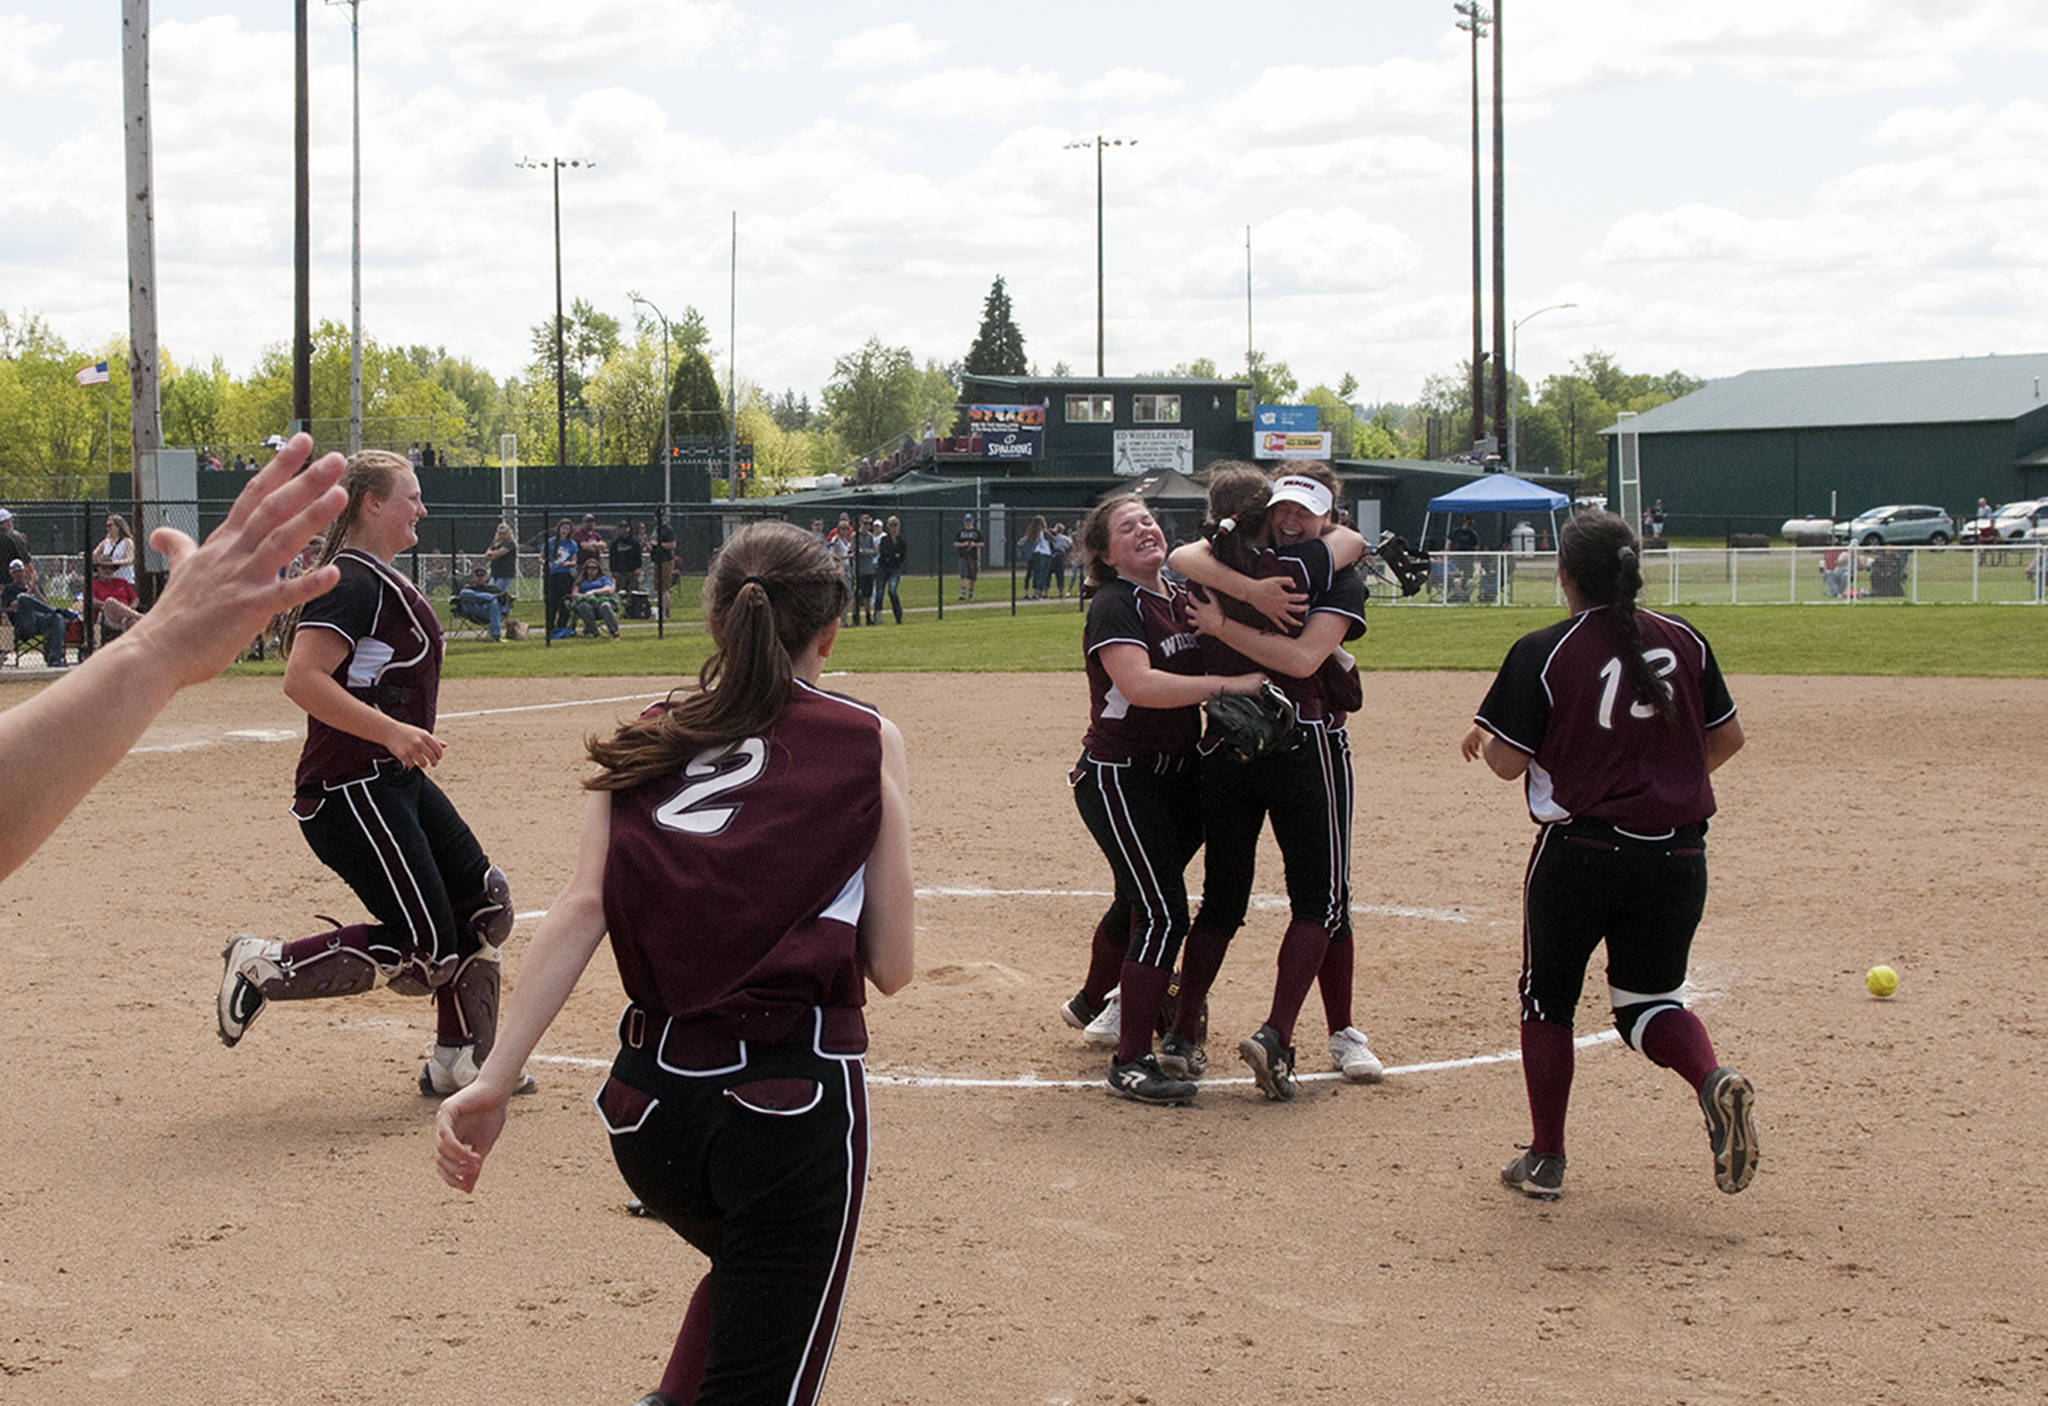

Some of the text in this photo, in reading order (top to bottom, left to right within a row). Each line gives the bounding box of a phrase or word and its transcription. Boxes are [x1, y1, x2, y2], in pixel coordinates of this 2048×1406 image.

[988, 442, 1033, 456] SPALDING
[1116, 431, 1128, 440] ED
[1169, 431, 1191, 440] FIELD
[1599, 647, 1678, 729] 13
[652, 736, 769, 837] 2
